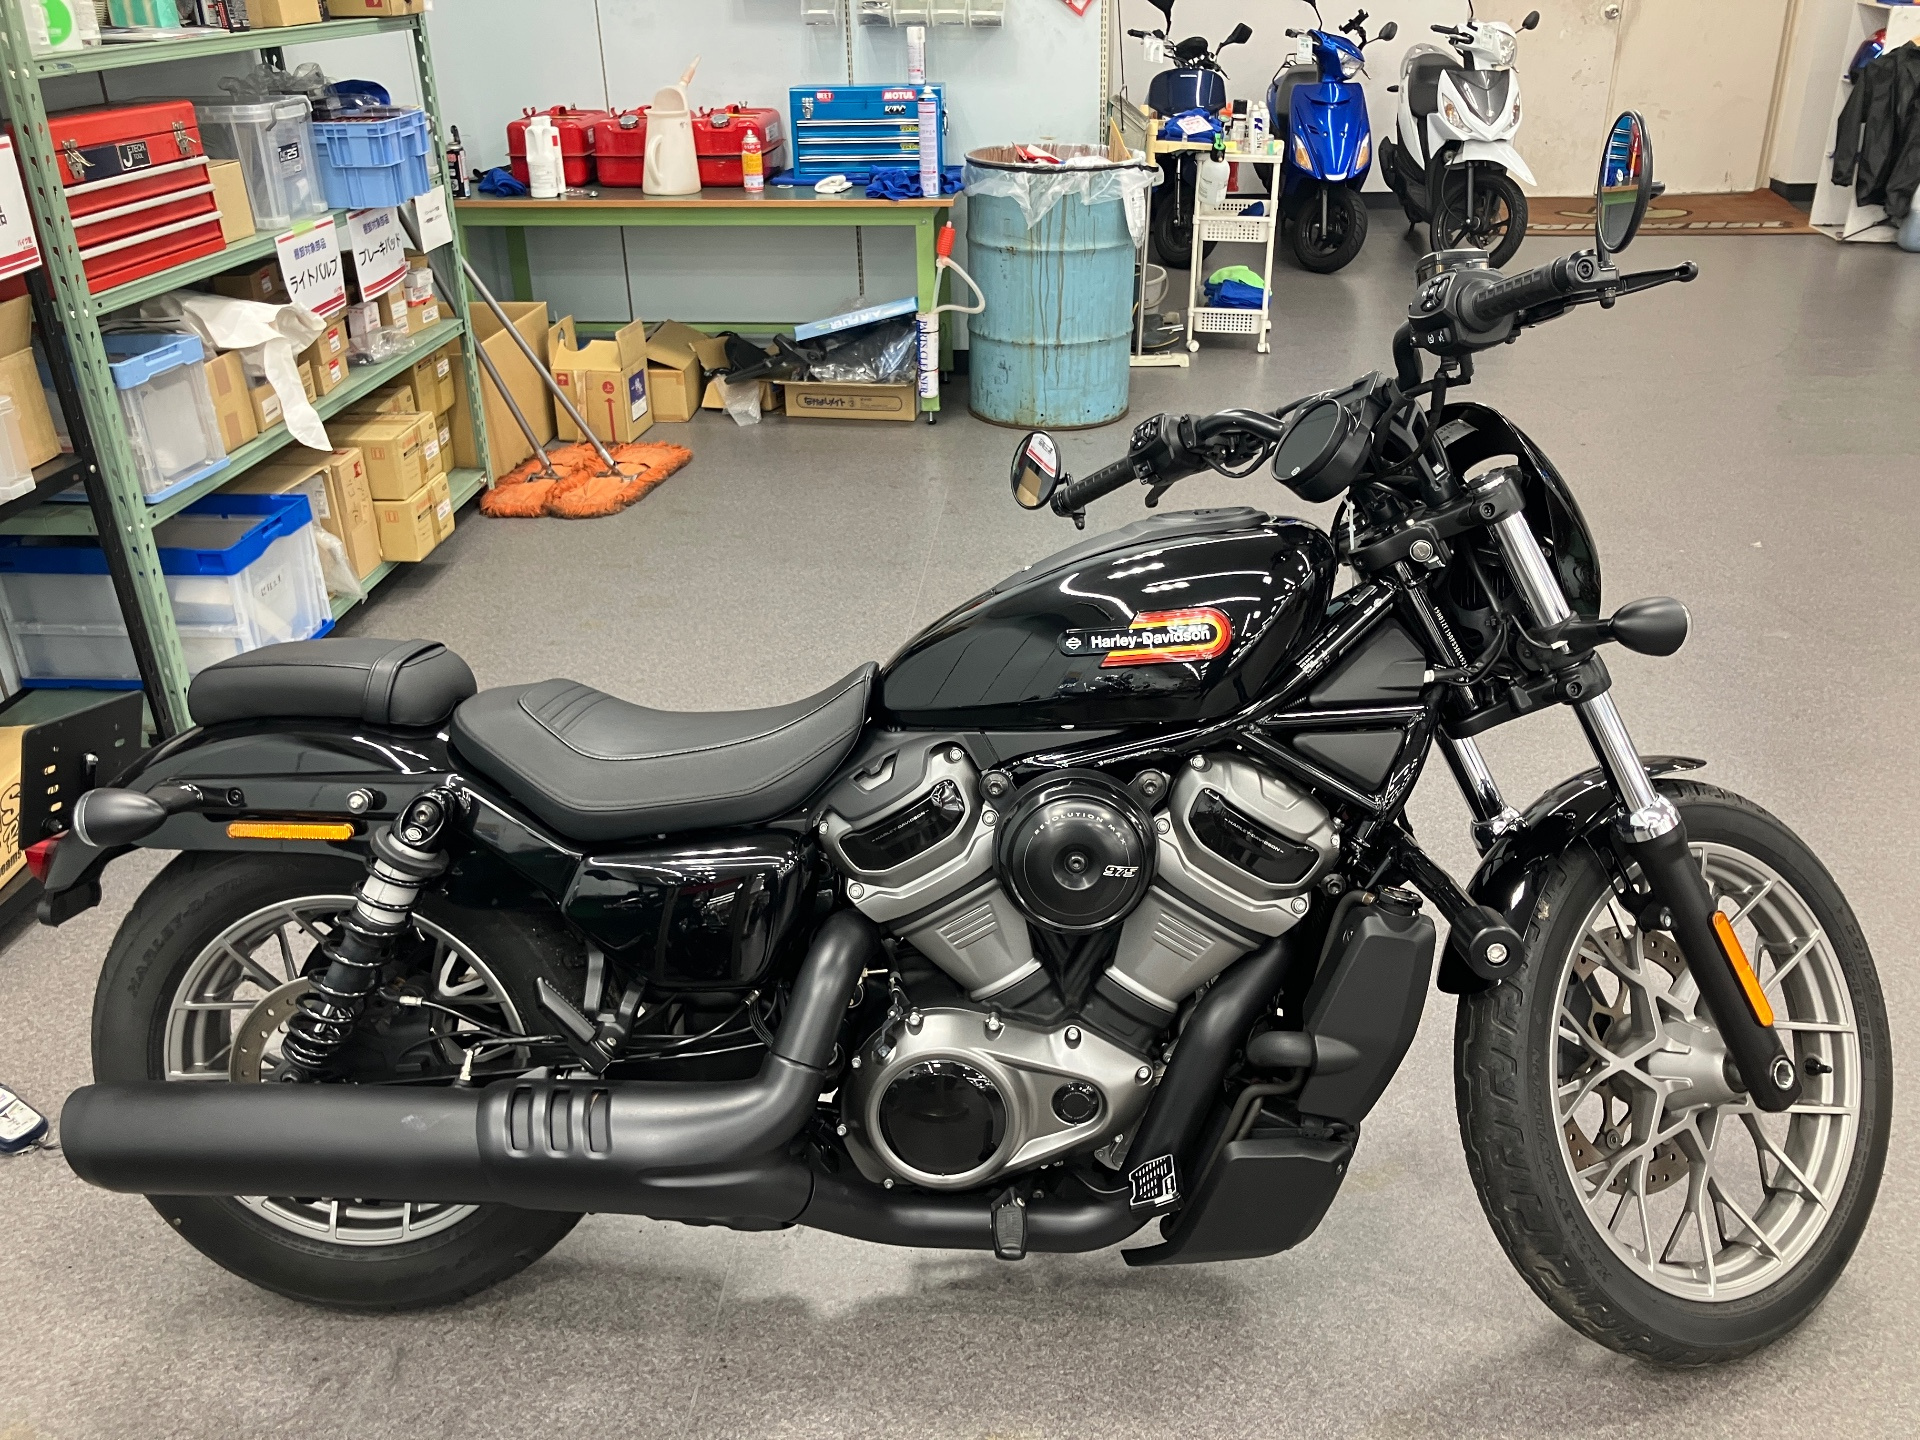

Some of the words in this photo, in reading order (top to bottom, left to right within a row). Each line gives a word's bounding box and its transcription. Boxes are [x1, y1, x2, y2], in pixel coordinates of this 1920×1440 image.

[883, 91, 915, 100] MOTUL
[1090, 628, 1211, 649] Harley-Davidson
[1034, 812, 1104, 836] REVOLUTION
[1107, 823, 1127, 845] MAX
